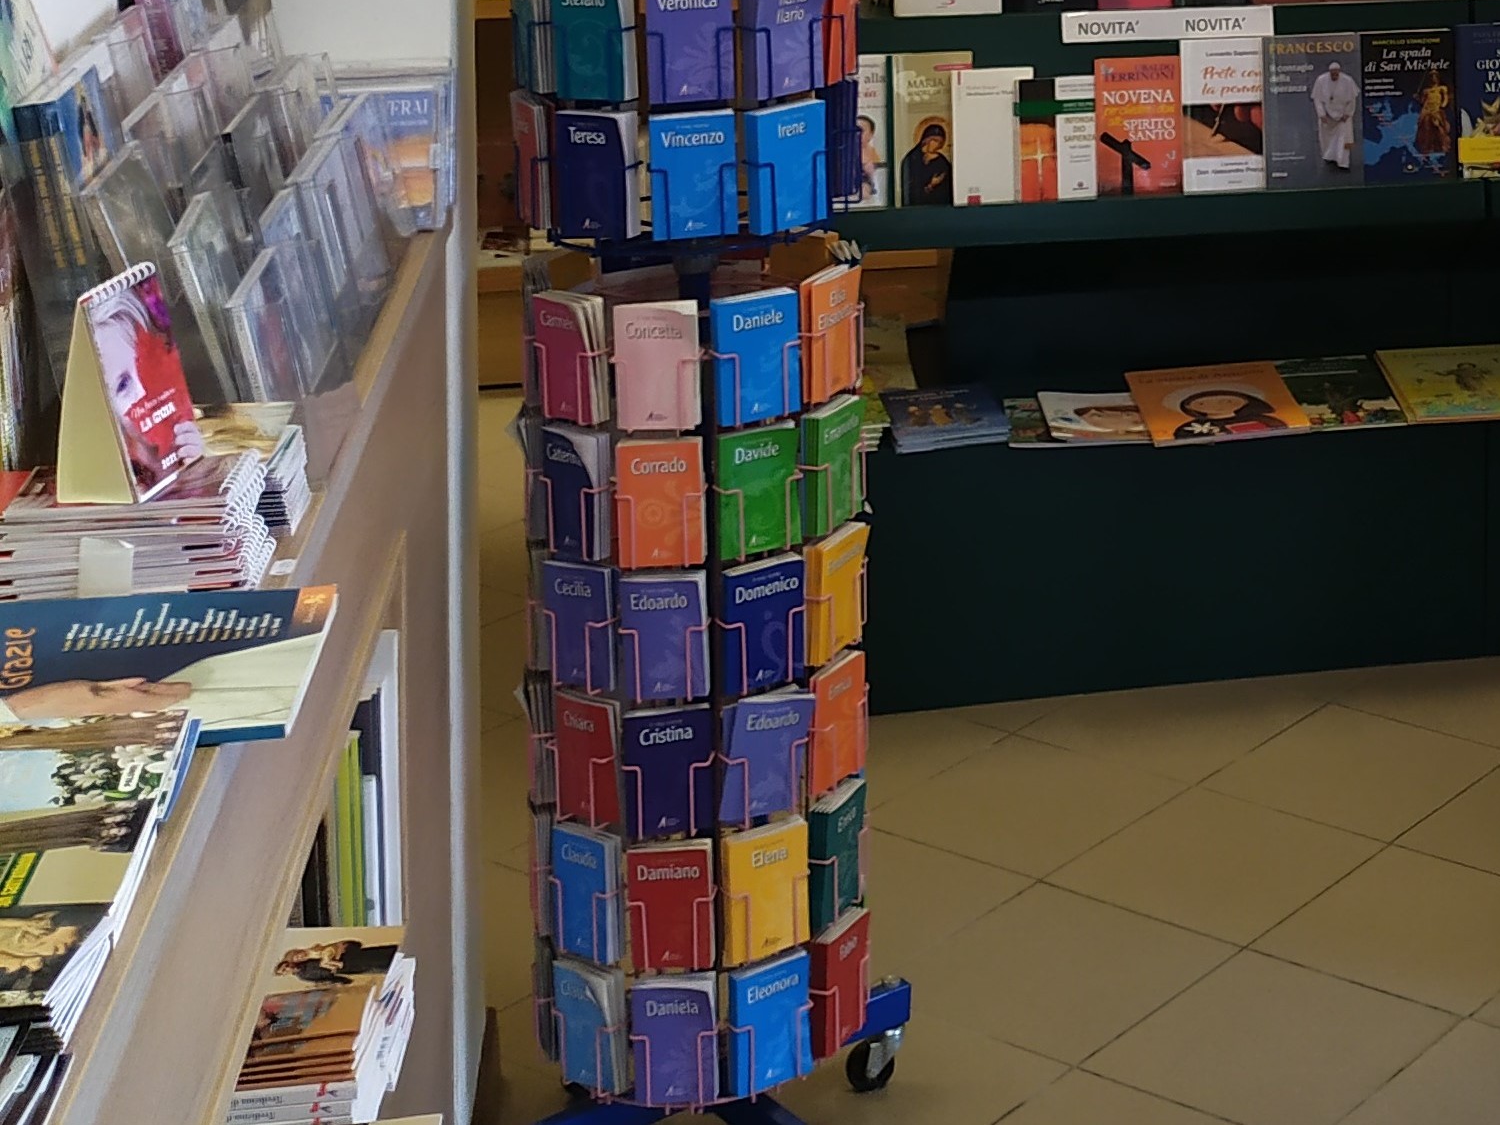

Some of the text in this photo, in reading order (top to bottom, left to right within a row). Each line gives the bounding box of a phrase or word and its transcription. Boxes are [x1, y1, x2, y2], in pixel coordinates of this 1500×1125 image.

[776, 7, 804, 24] Ilario
[1078, 21, 1139, 35] NOVITA'
[1185, 17, 1246, 32] NOVITA'
[1269, 41, 1354, 54] FRANCESCO
[1382, 47, 1432, 60] La spada
[1365, 59, 1449, 71] di San Michele
[1103, 90, 1174, 105] NOVENA
[778, 121, 805, 138] Irene
[1124, 119, 1175, 131] SPIRITO
[568, 128, 606, 145] Teresa
[661, 131, 724, 148] Vincenzo
[1129, 130, 1176, 140] SANTO
[732, 310, 783, 332] Daniele
[625, 323, 682, 340] Concetta
[735, 443, 779, 465] Davide
[630, 458, 686, 474] Corrado
[554, 579, 591, 598] Cecilia
[735, 577, 799, 603] Domenico
[630, 594, 688, 611] Edoardo
[0, 627, 36, 690] Grazie
[746, 712, 799, 731] Edoardo
[639, 726, 693, 745] Cristina
[637, 865, 699, 881] Damiano
[747, 974, 799, 1005] Eleonora
[646, 1000, 699, 1016] Daniela
